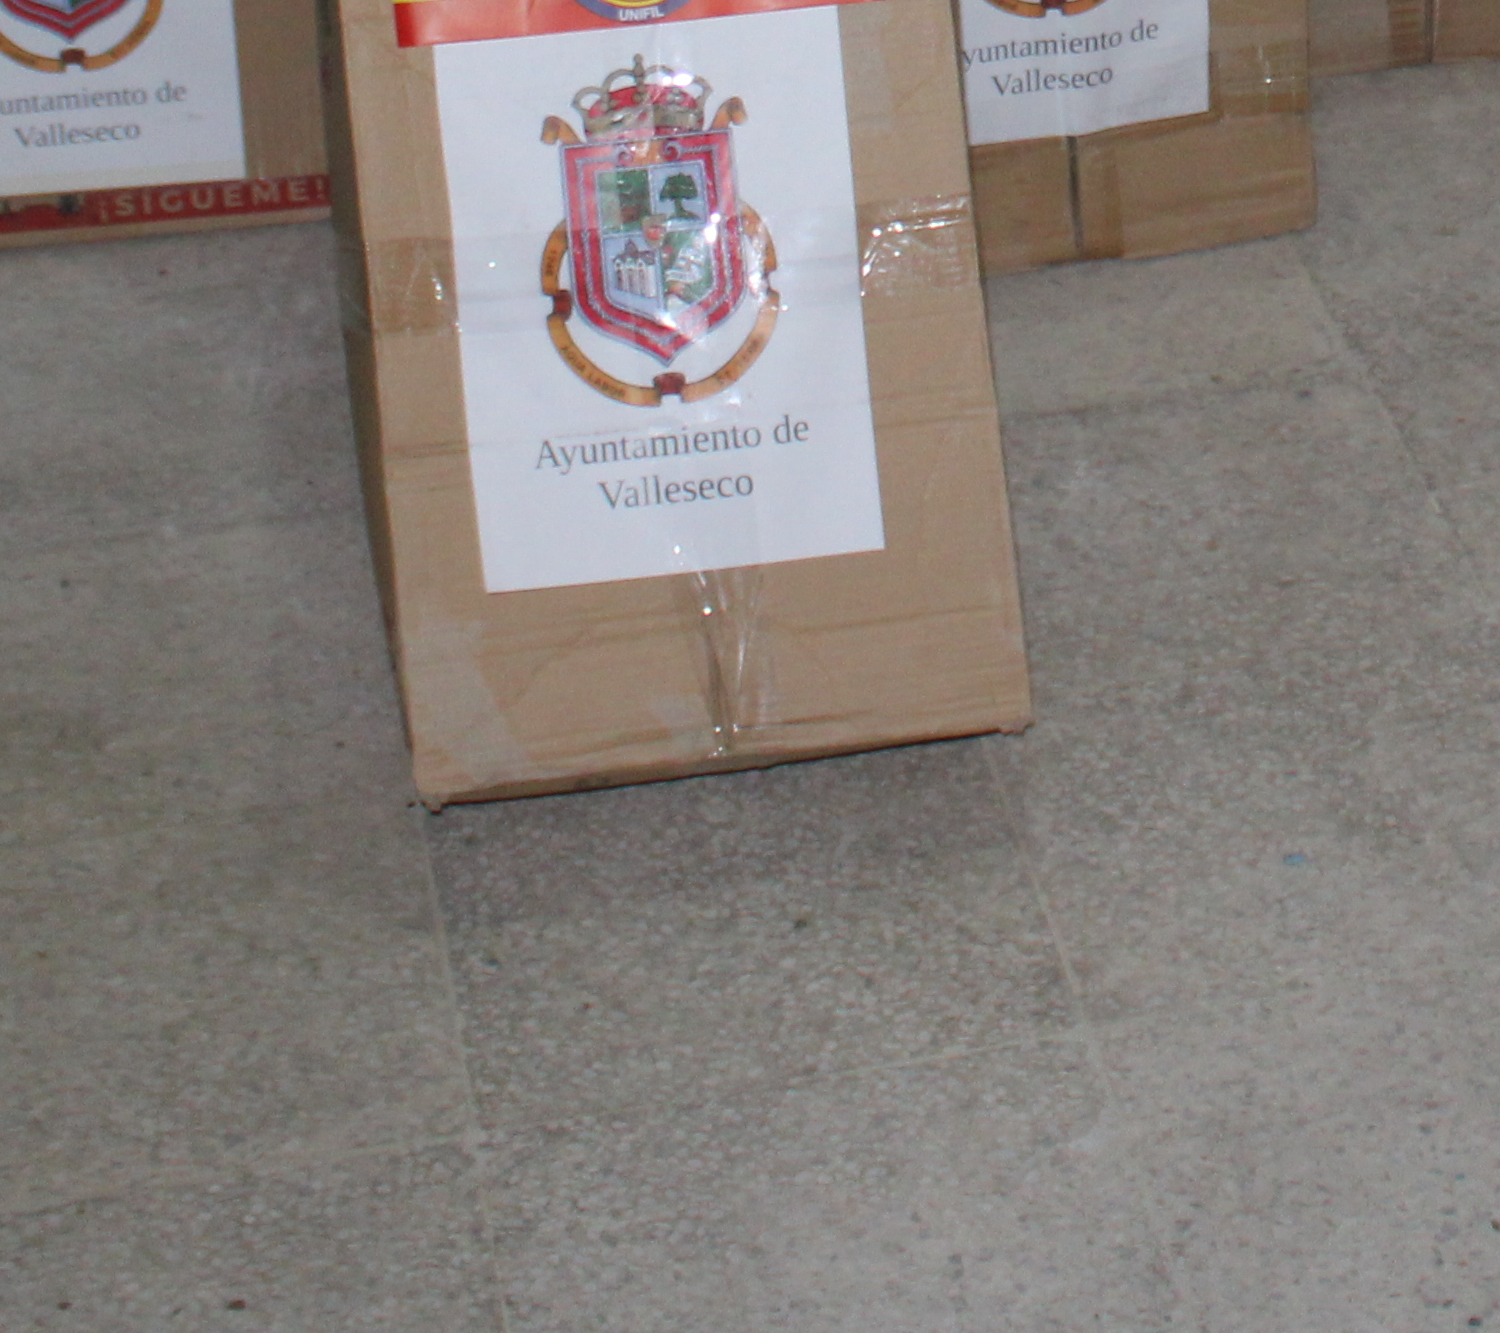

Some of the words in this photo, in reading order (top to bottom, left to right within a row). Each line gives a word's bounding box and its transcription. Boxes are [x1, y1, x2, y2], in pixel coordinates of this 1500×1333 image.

[617, 6, 666, 21] UNIFIL
[961, 32, 1123, 72] yuntamiento
[1130, 19, 1160, 43] de
[156, 80, 188, 103] de
[991, 66, 1114, 96] Valleseco
[14, 121, 141, 149] Valleseco
[535, 425, 762, 475] Ayuntamiento
[773, 414, 810, 445] de
[598, 473, 755, 510] Valleseco
